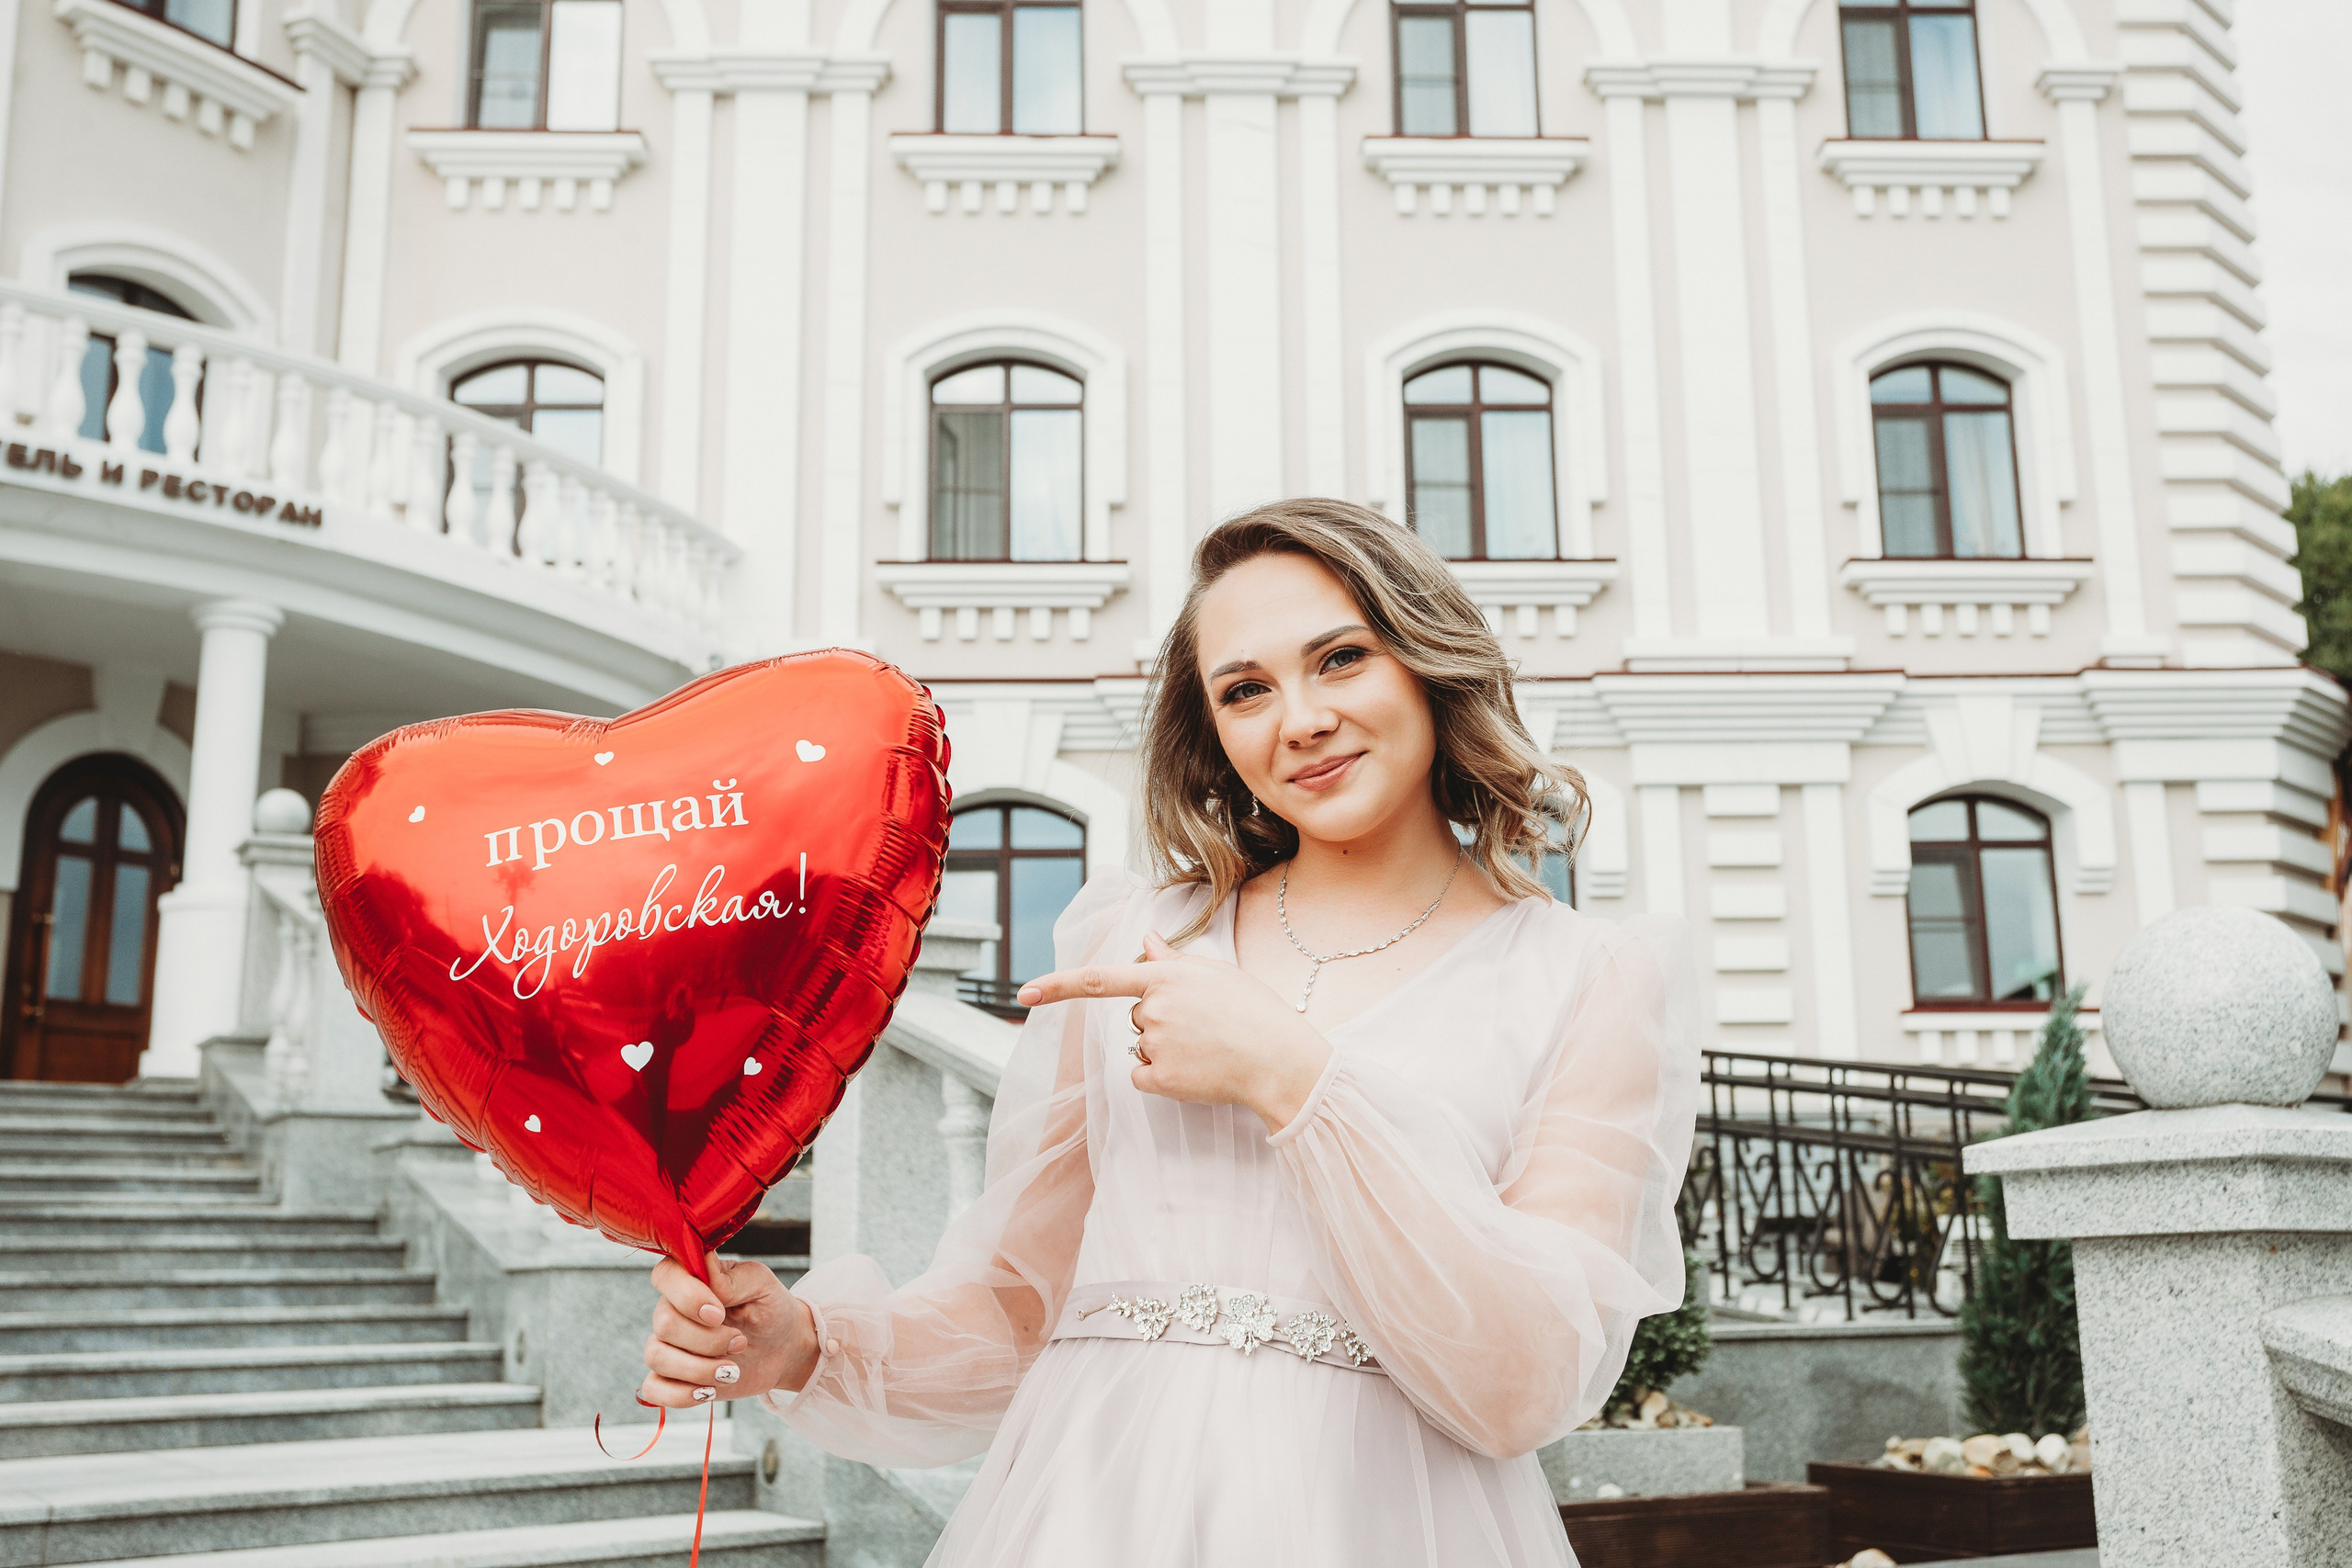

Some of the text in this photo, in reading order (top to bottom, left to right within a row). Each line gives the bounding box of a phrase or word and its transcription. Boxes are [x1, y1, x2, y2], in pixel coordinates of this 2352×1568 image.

[0, 440, 322, 528] ЕЛЬ И РЕСТОРАН
[483, 777, 749, 871] прощай
[449, 851, 808, 999] Ходоровская!
